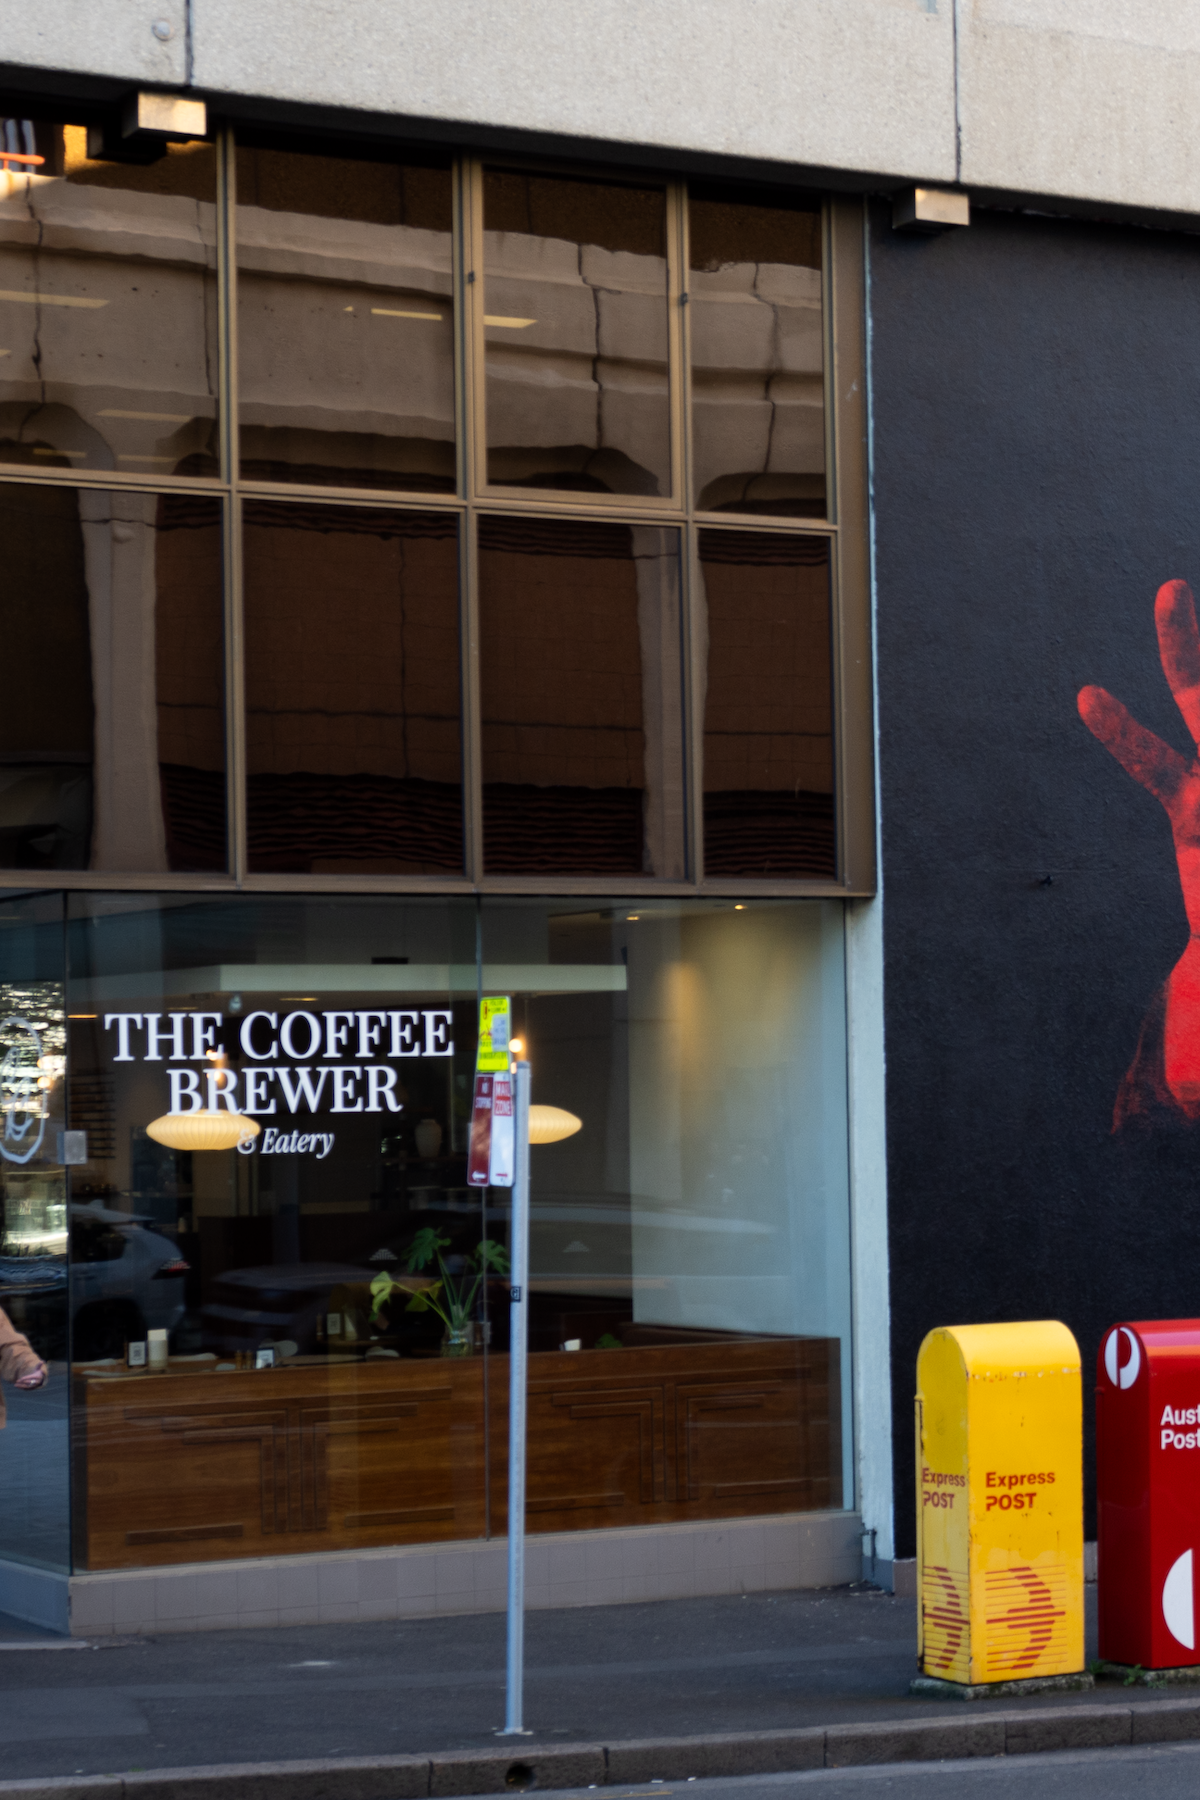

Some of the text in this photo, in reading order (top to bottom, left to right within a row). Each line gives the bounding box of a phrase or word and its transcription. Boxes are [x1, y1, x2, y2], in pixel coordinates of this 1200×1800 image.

[104, 1012, 224, 1062] THE
[239, 1010, 455, 1060] COFFEE
[166, 1065, 404, 1116] BREWER
[495, 1082, 511, 1096] MAIL
[495, 1100, 511, 1115] ZONE
[236, 1127, 335, 1159] & Eatery
[922, 1467, 966, 1488] Express
[985, 1472, 1056, 1491] Express
[922, 1491, 955, 1509] POST
[985, 1492, 1037, 1512] POST
